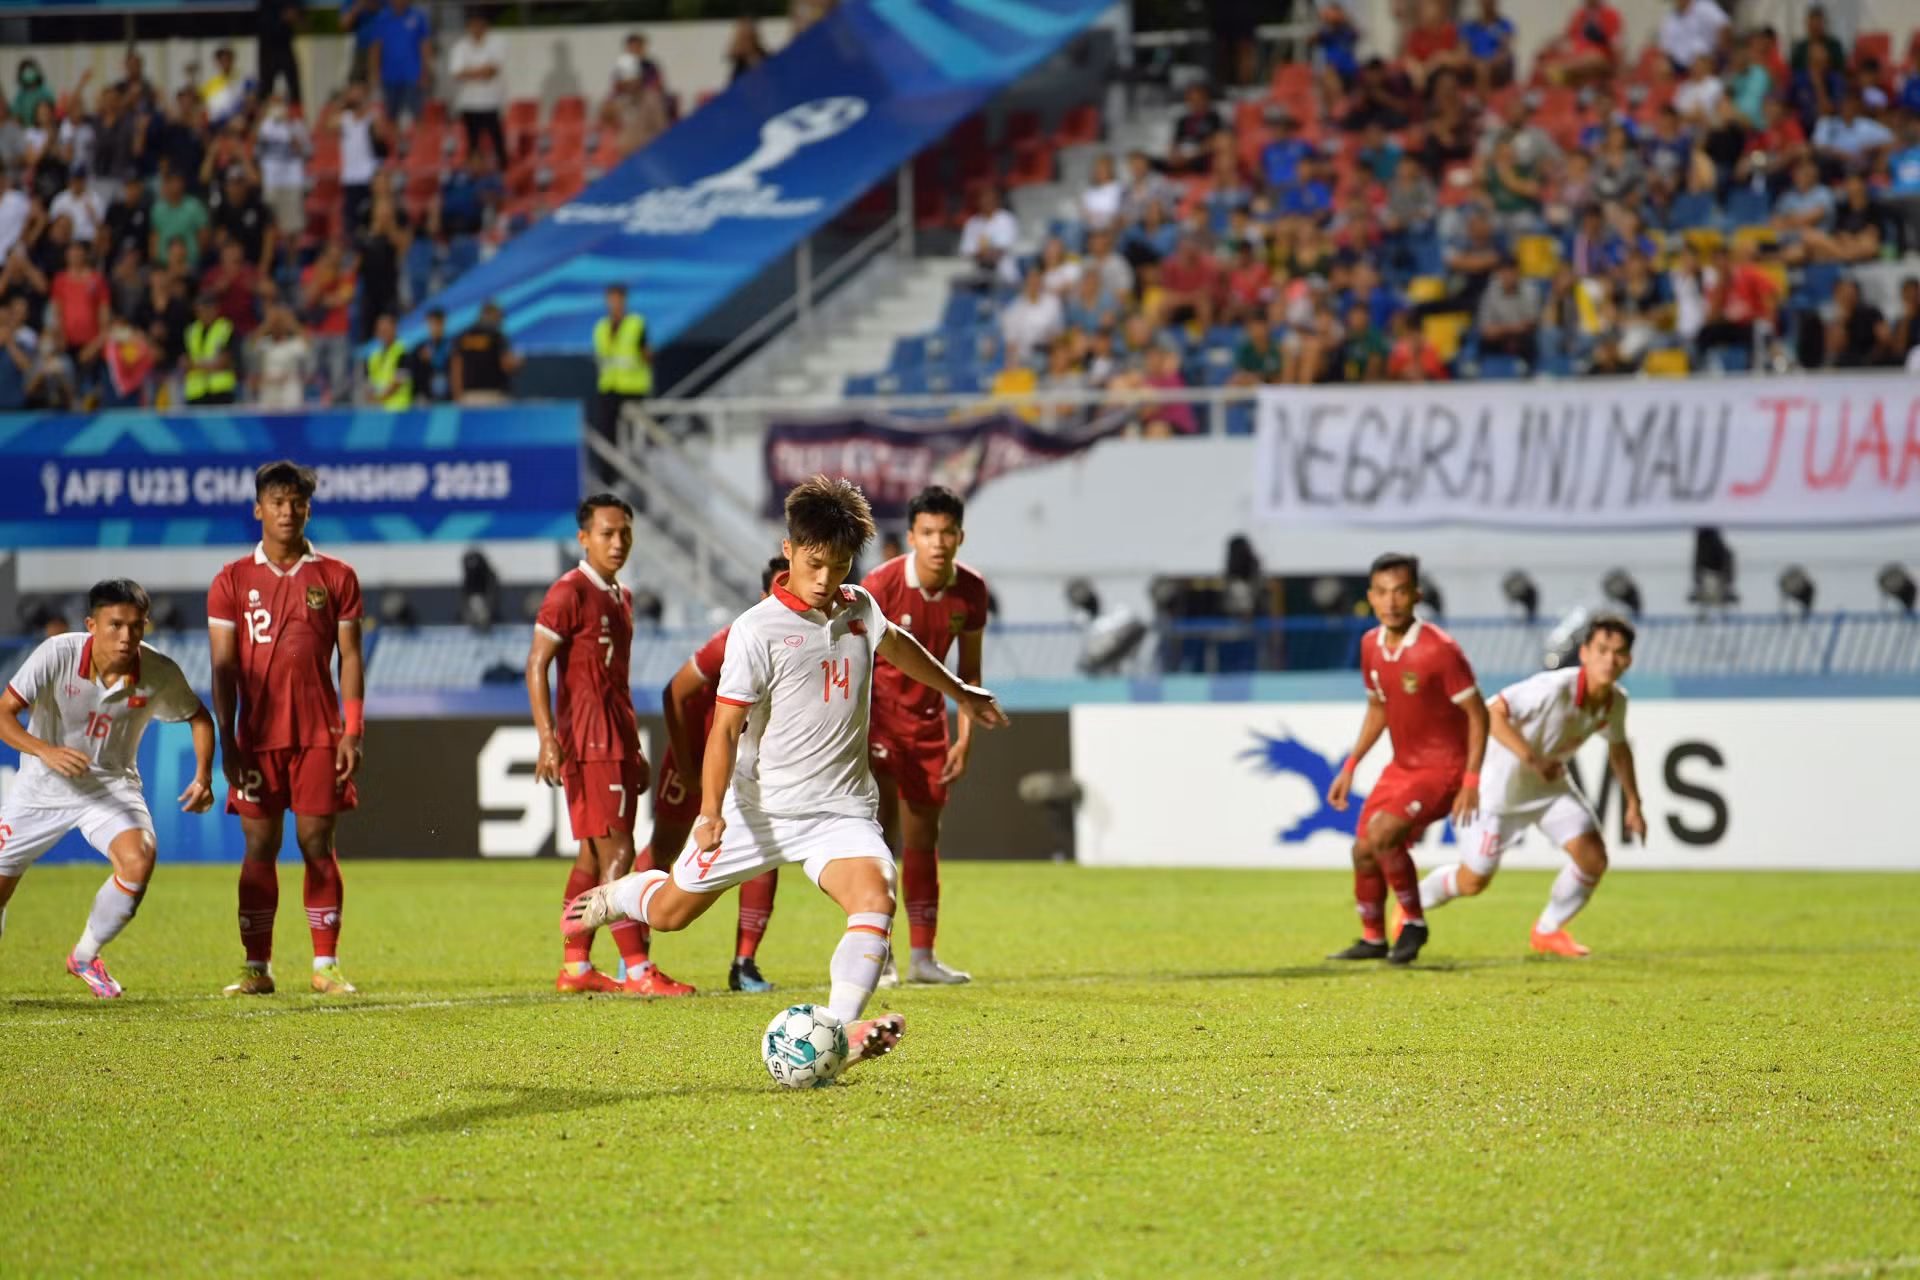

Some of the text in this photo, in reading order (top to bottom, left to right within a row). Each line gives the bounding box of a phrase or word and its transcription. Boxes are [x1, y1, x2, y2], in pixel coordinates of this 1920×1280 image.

[1270, 402, 1493, 508] NEGARA
[1591, 402, 1731, 507] MAU
[63, 461, 511, 505] AFF U23 CHAONSHIP 2023
[243, 608, 272, 645] 12
[598, 636, 614, 668] 7
[821, 657, 850, 703] 14
[84, 711, 113, 739] 16
[608, 783, 626, 818] 7
[659, 768, 688, 805] 15
[684, 847, 723, 880] 14
